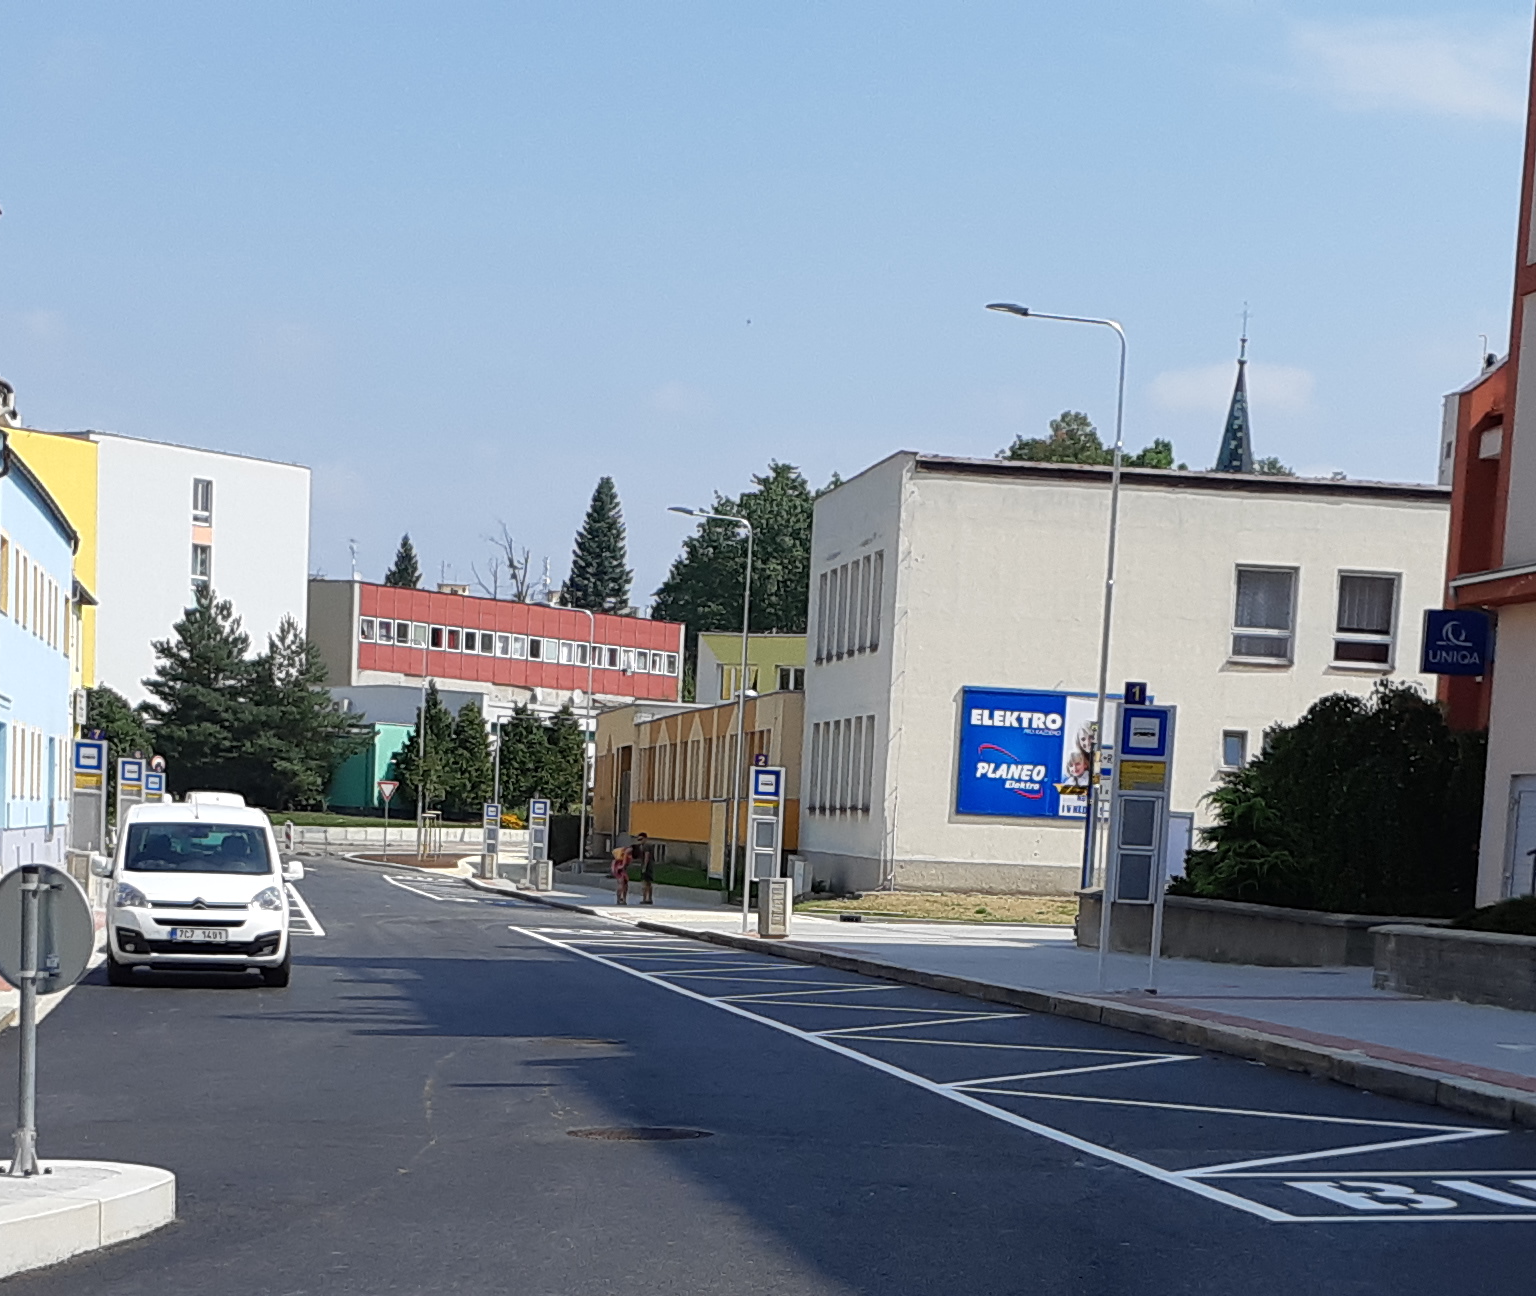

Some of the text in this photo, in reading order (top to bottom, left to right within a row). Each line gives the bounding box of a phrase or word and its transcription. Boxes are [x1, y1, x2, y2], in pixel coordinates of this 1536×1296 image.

[1428, 650, 1480, 664] UNIQA
[1132, 686, 1141, 701] 1
[970, 709, 1063, 730] ELEKTRO
[758, 755, 766, 765] 2
[976, 762, 1046, 781] PLANEO
[1005, 780, 1040, 790] Elektro
